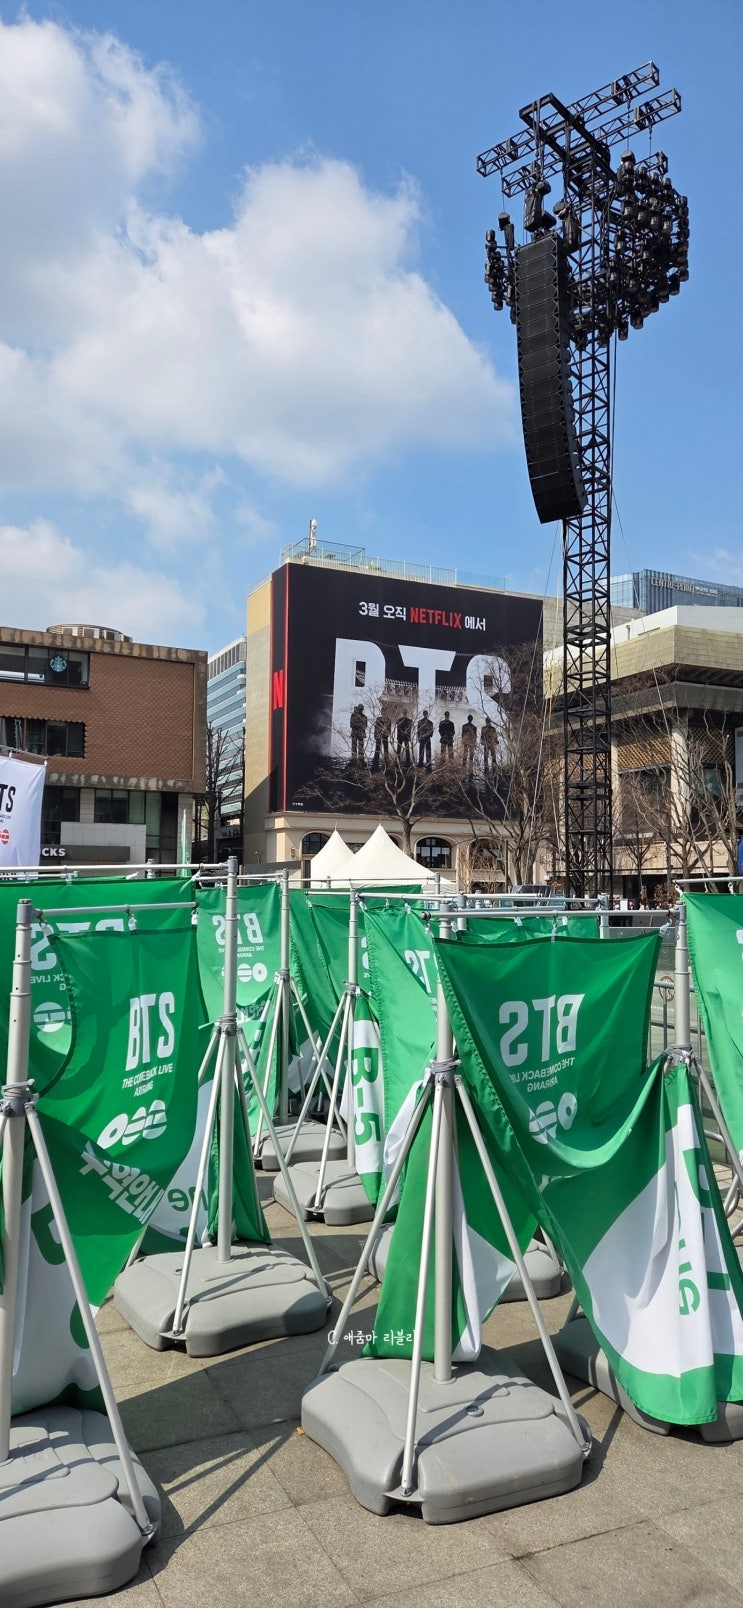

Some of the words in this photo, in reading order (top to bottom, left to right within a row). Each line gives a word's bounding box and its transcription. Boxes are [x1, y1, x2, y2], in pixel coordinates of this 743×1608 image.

[358, 601, 380, 618] 3월
[383, 603, 407, 622] 오직
[410, 606, 462, 630] NETFLIX
[464, 615, 486, 632] 에서
[273, 669, 284, 710] N
[330, 637, 512, 766] BTS
[124, 991, 175, 1072] BTS
[121, 1076, 134, 1089] THE
[157, 1062, 174, 1075] LIVE
[351, 1047, 382, 1146] B-5
